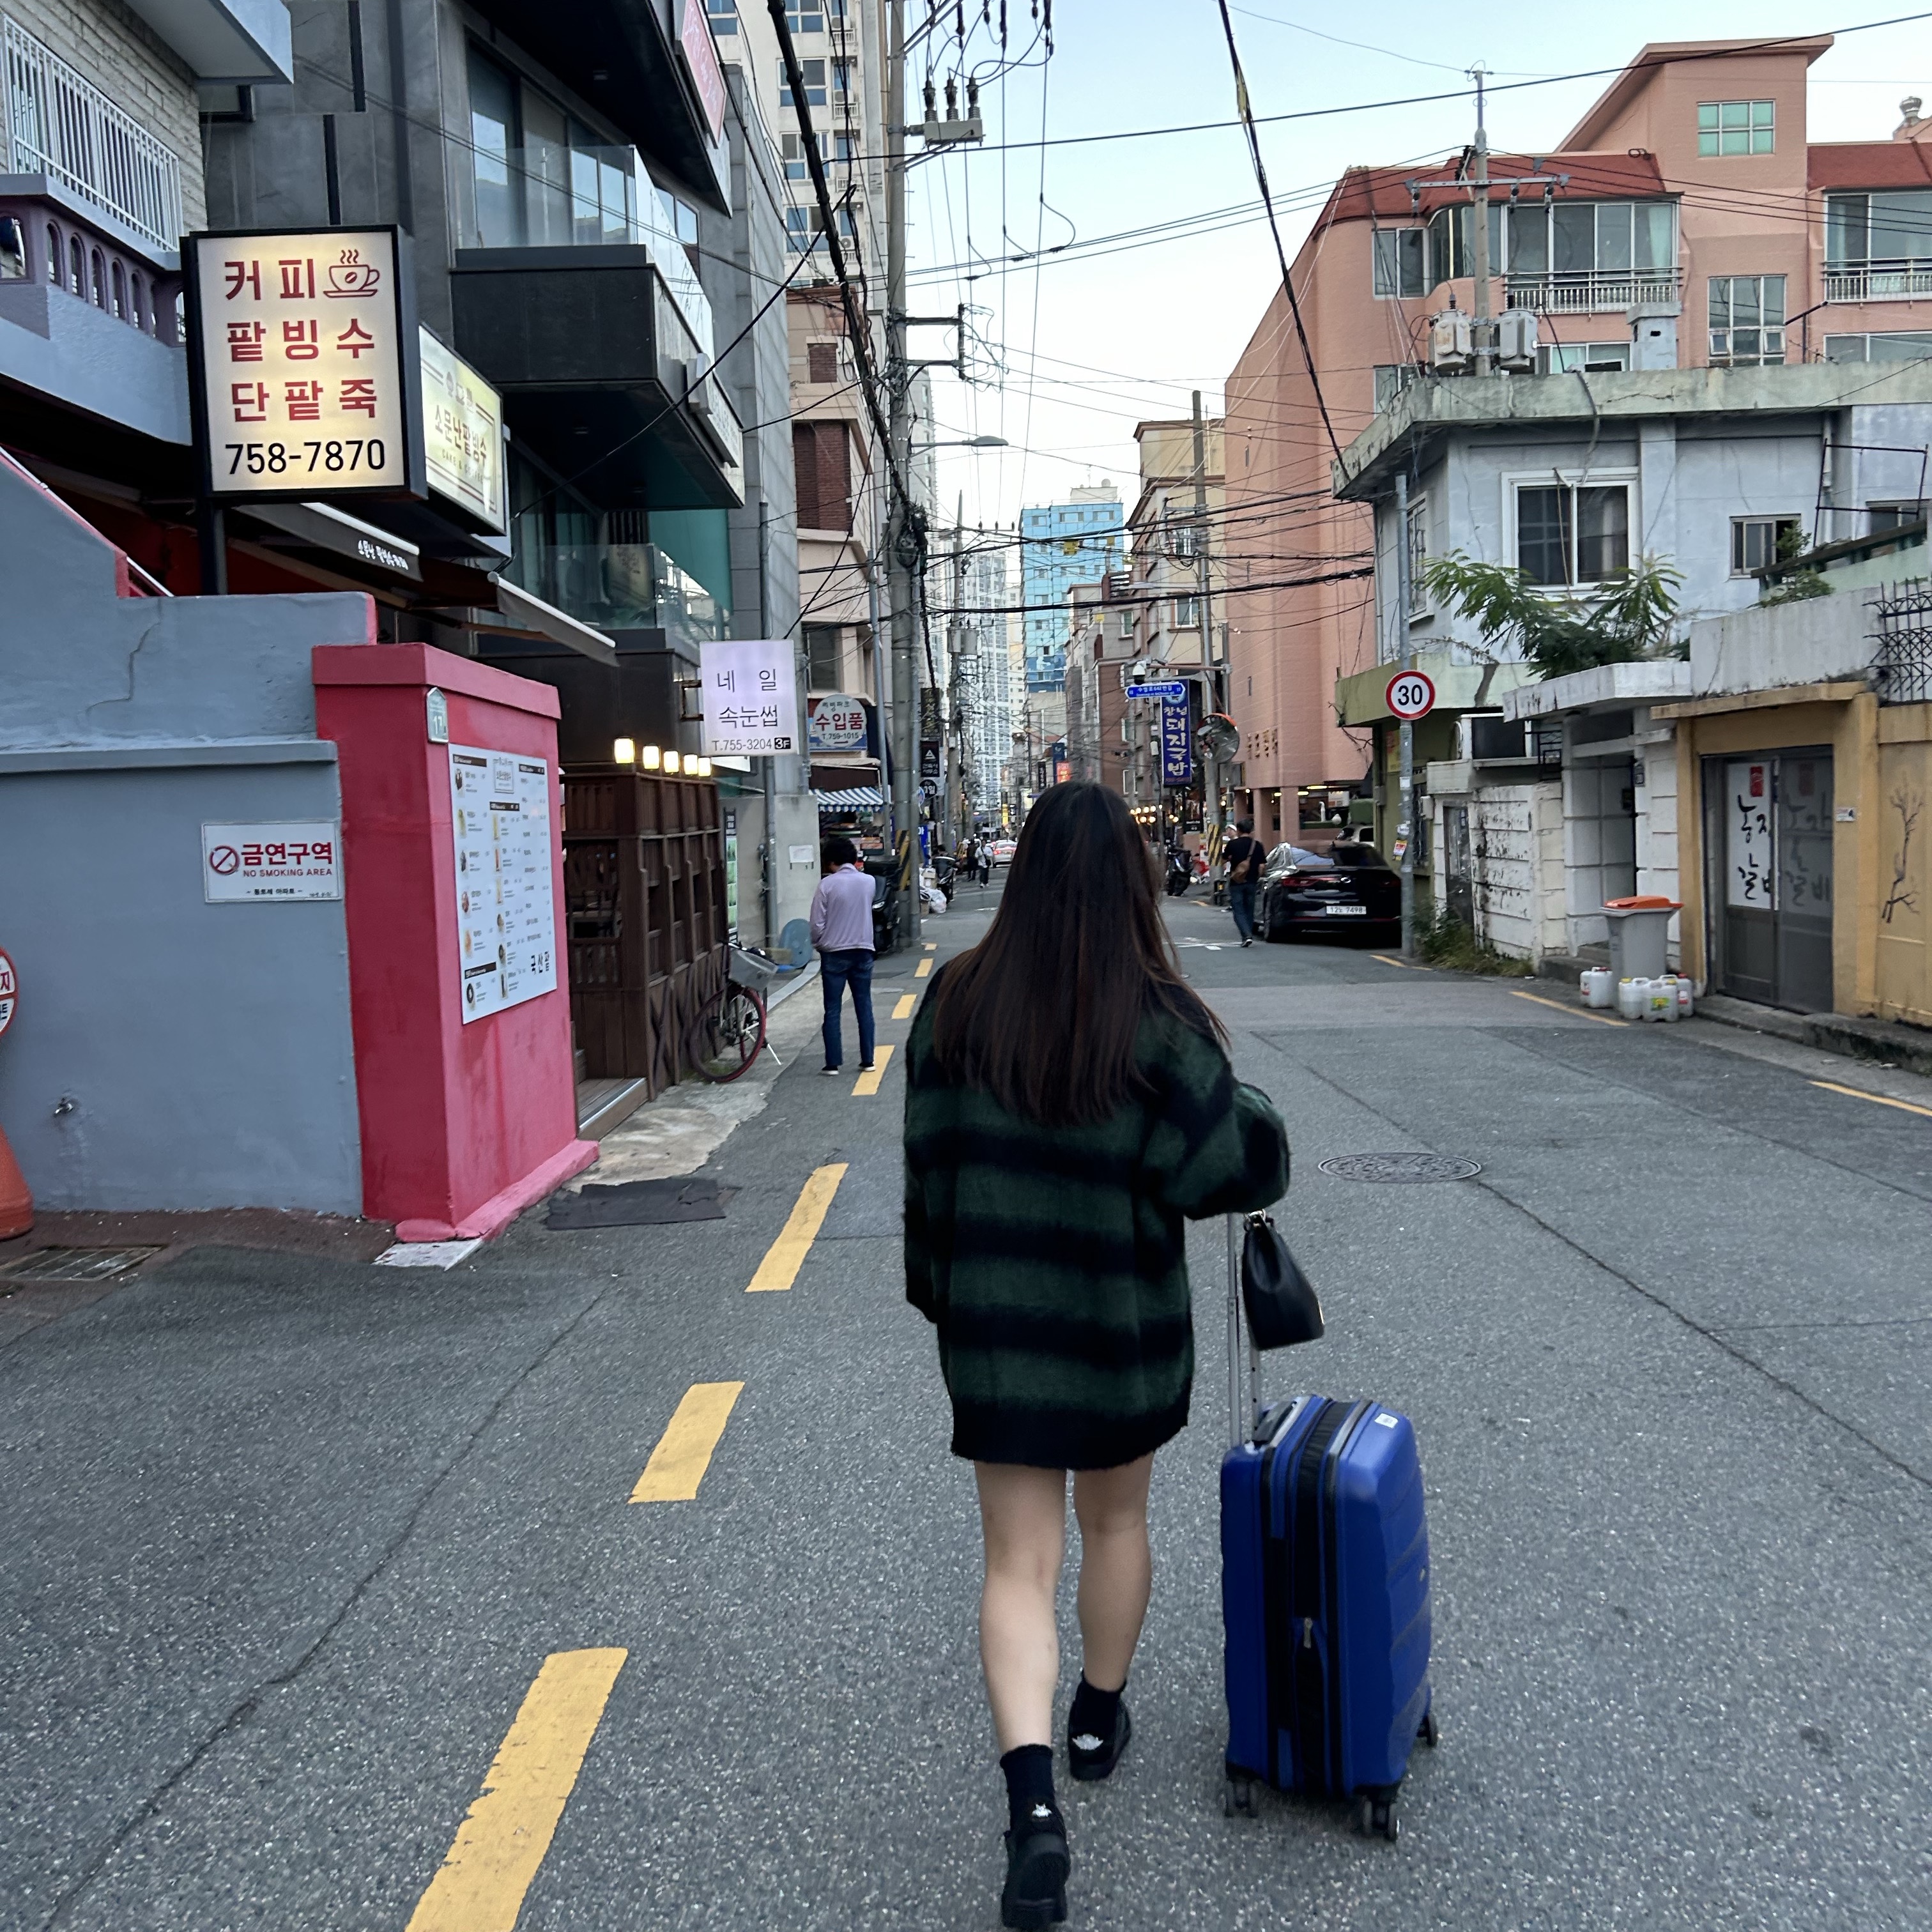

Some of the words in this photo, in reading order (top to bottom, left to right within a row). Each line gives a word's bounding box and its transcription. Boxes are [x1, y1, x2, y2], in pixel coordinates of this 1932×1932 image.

[225, 259, 316, 300] 커피
[227, 318, 375, 362] 팥빙수
[231, 378, 377, 423] 단팥죽
[225, 439, 385, 475] 758-7870
[1397, 685, 1423, 706] 30
[719, 704, 778, 728] 속눈썹
[815, 712, 864, 732] 수입품
[1163, 706, 1188, 716] 창녕
[775, 739, 791, 749] 3F
[1165, 717, 1188, 776] 돼지국밥
[241, 841, 332, 866] 금연구역
